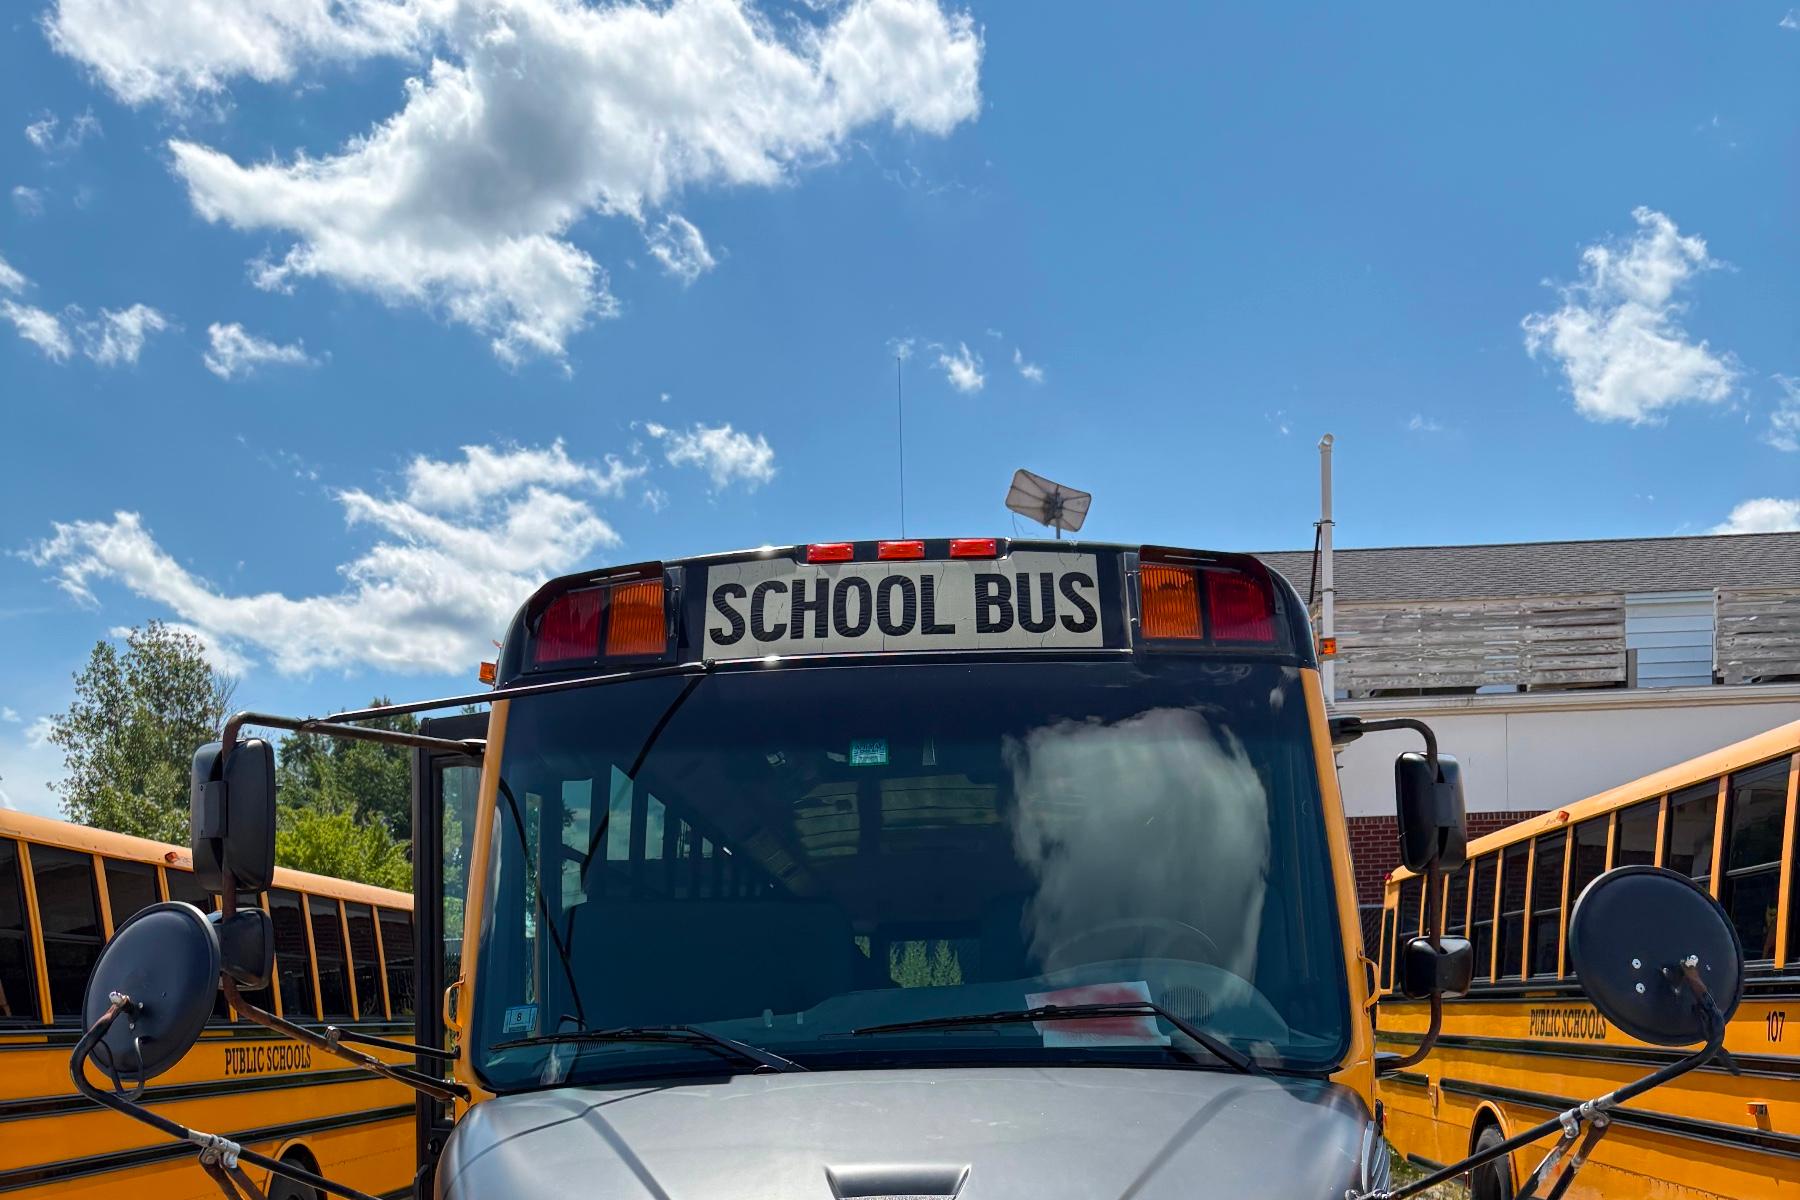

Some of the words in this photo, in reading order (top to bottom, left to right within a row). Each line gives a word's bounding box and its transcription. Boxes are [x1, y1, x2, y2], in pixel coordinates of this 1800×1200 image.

[709, 574, 956, 646] SCHOOL
[974, 571, 1098, 635] BUS
[1529, 1008, 1561, 1037] PUBLIC
[1561, 1008, 1606, 1040] SCHOOLS
[1766, 1010, 1786, 1042] 107
[224, 1045, 265, 1075] PUBLIC
[266, 1044, 311, 1072] SCHOOLS
